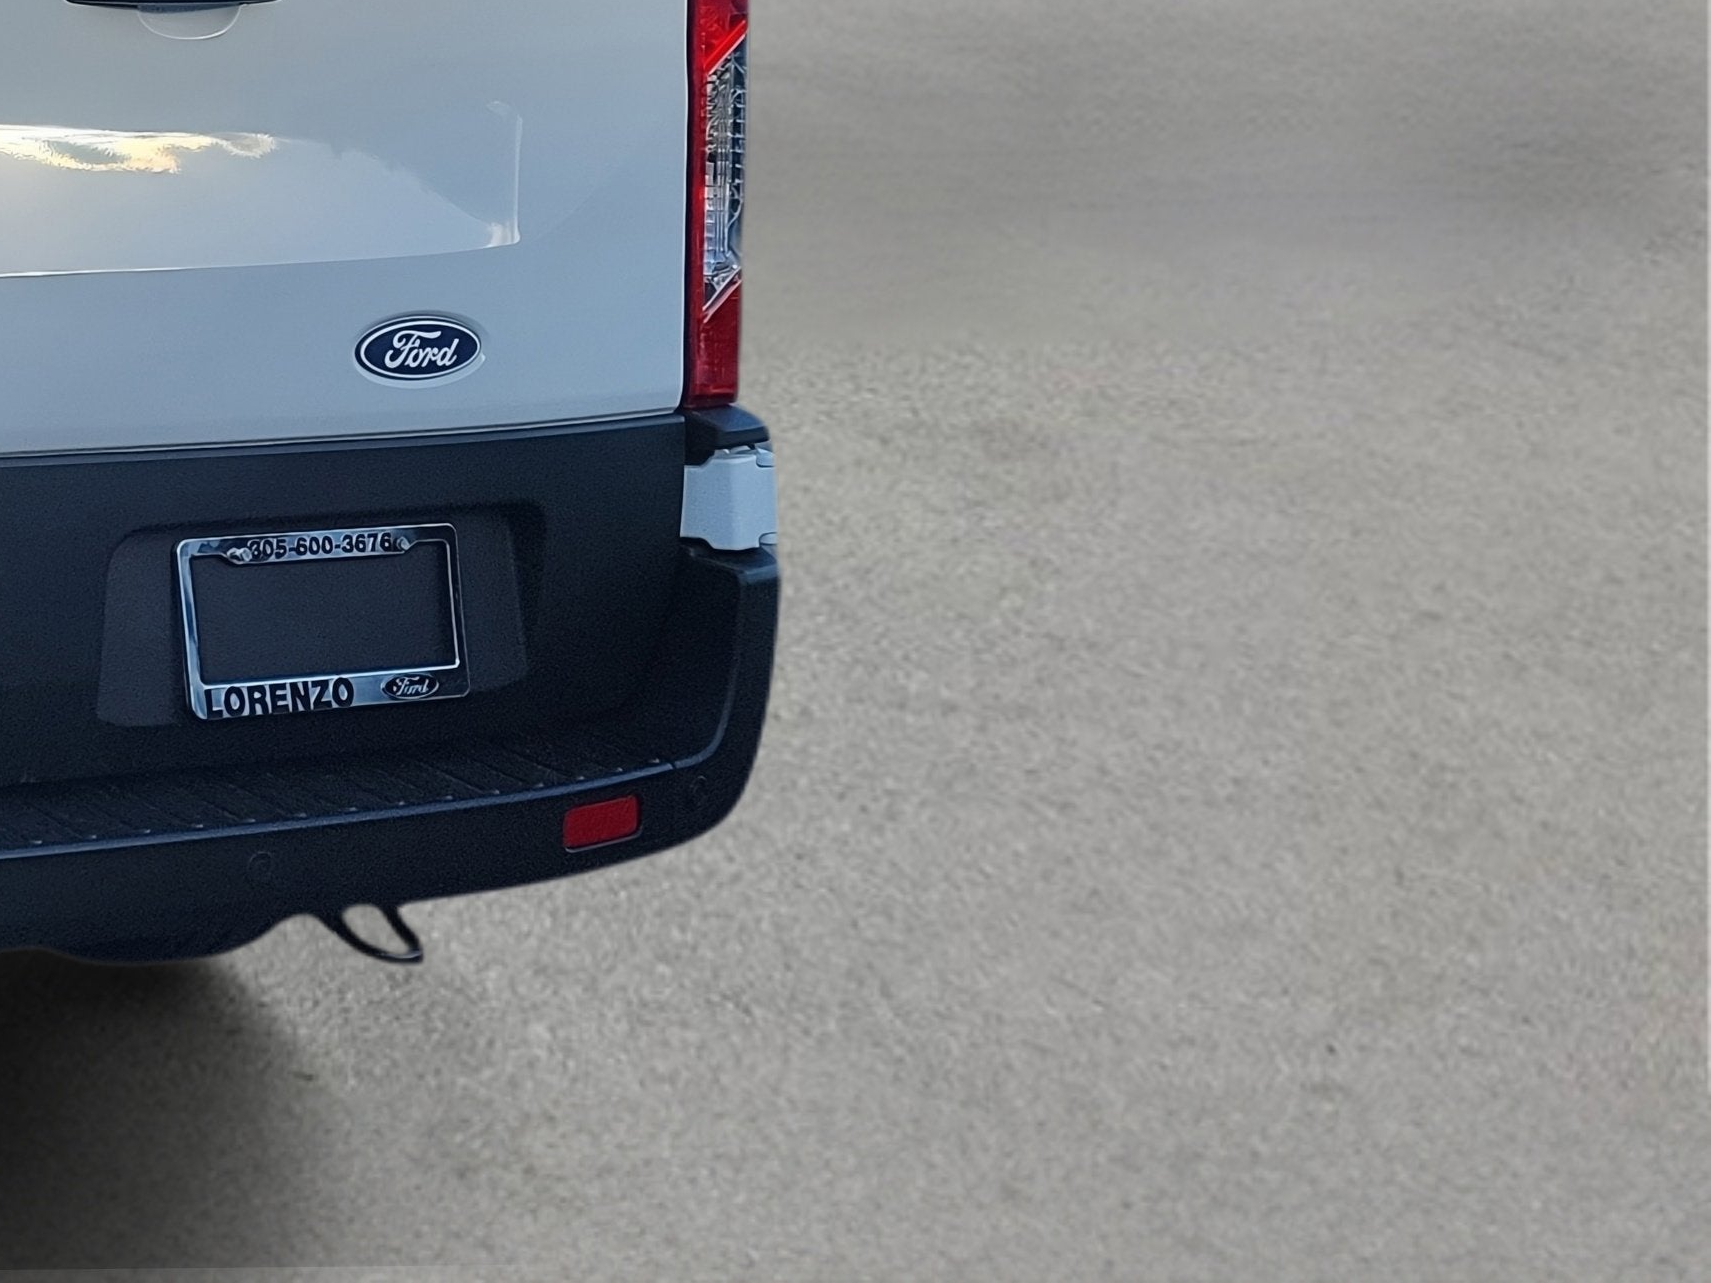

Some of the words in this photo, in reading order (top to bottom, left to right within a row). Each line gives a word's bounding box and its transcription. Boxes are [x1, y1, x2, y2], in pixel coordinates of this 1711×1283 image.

[384, 329, 460, 369] Ford
[246, 531, 393, 562] 305-600-3676
[203, 676, 355, 720] LORENZO
[391, 675, 431, 698] Ford
